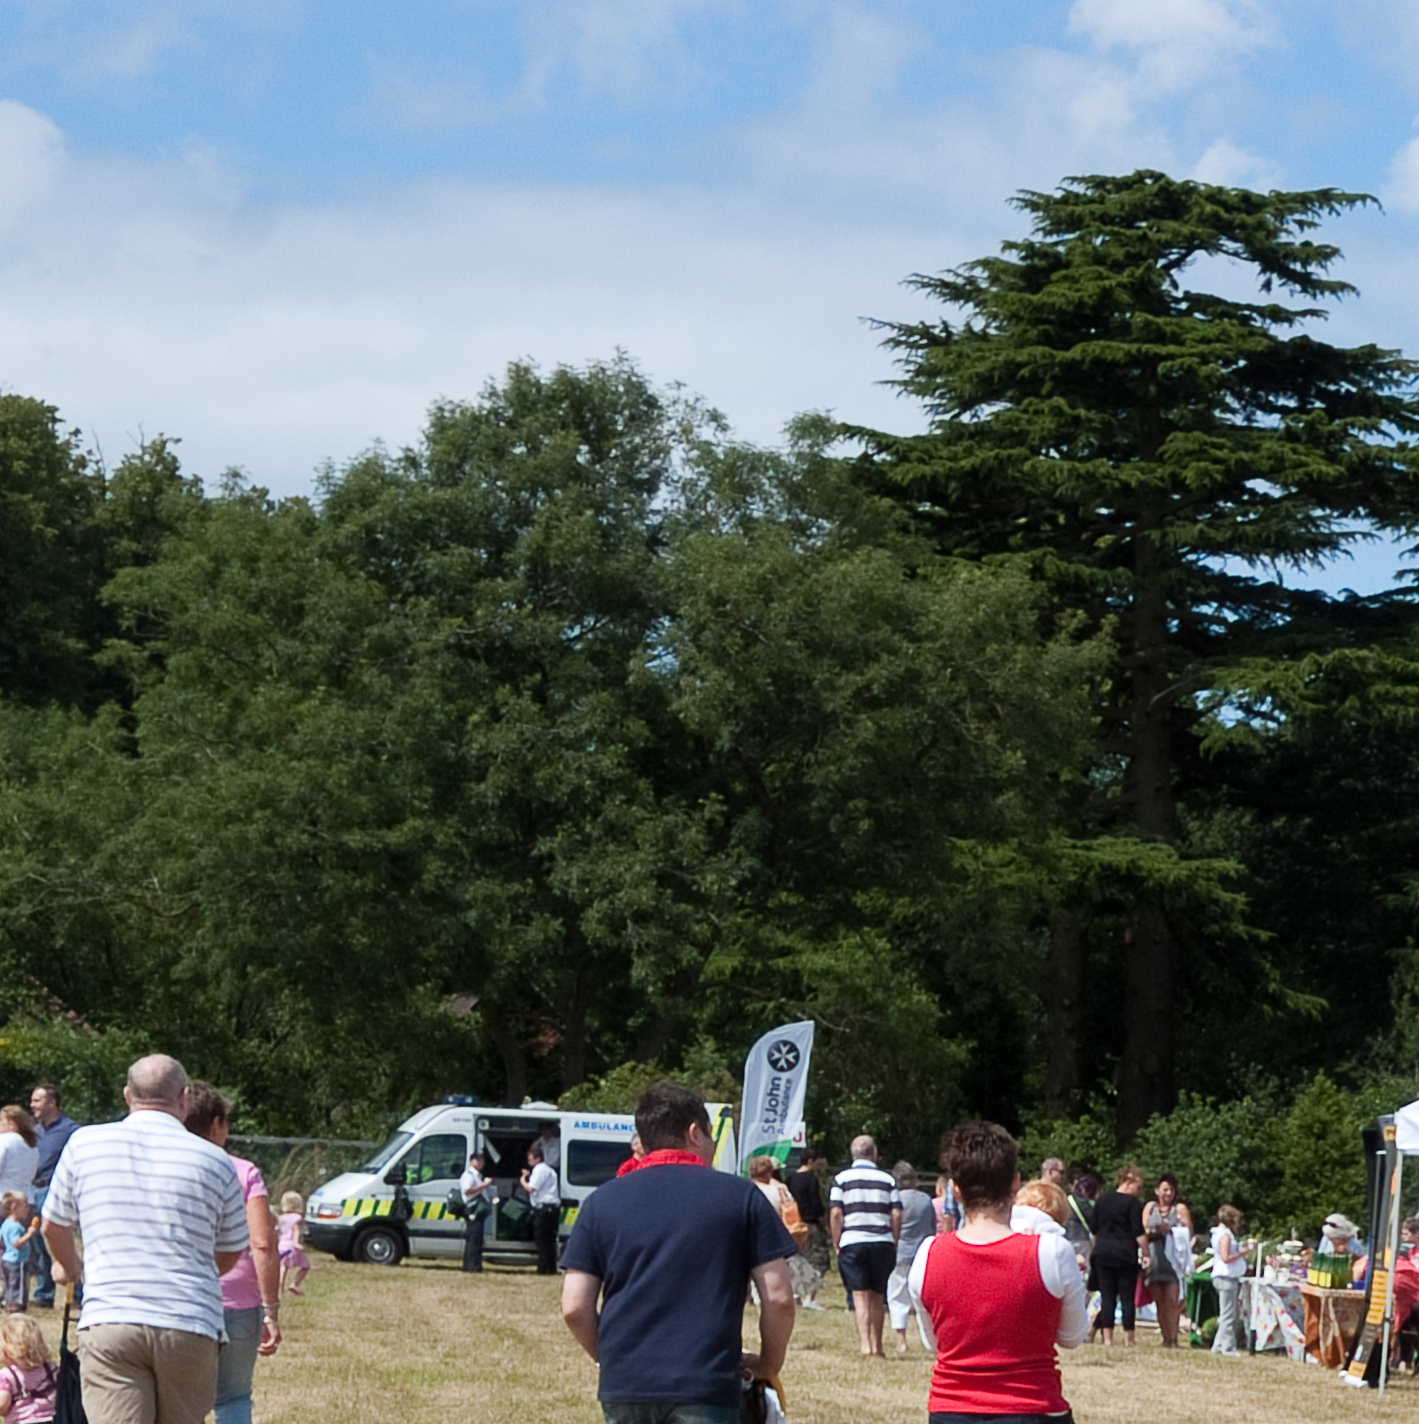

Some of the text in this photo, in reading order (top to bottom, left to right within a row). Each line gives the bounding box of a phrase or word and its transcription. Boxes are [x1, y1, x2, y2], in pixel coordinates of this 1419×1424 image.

[761, 1076, 782, 1134] St John
[574, 1120, 635, 1132] AMBULANC
